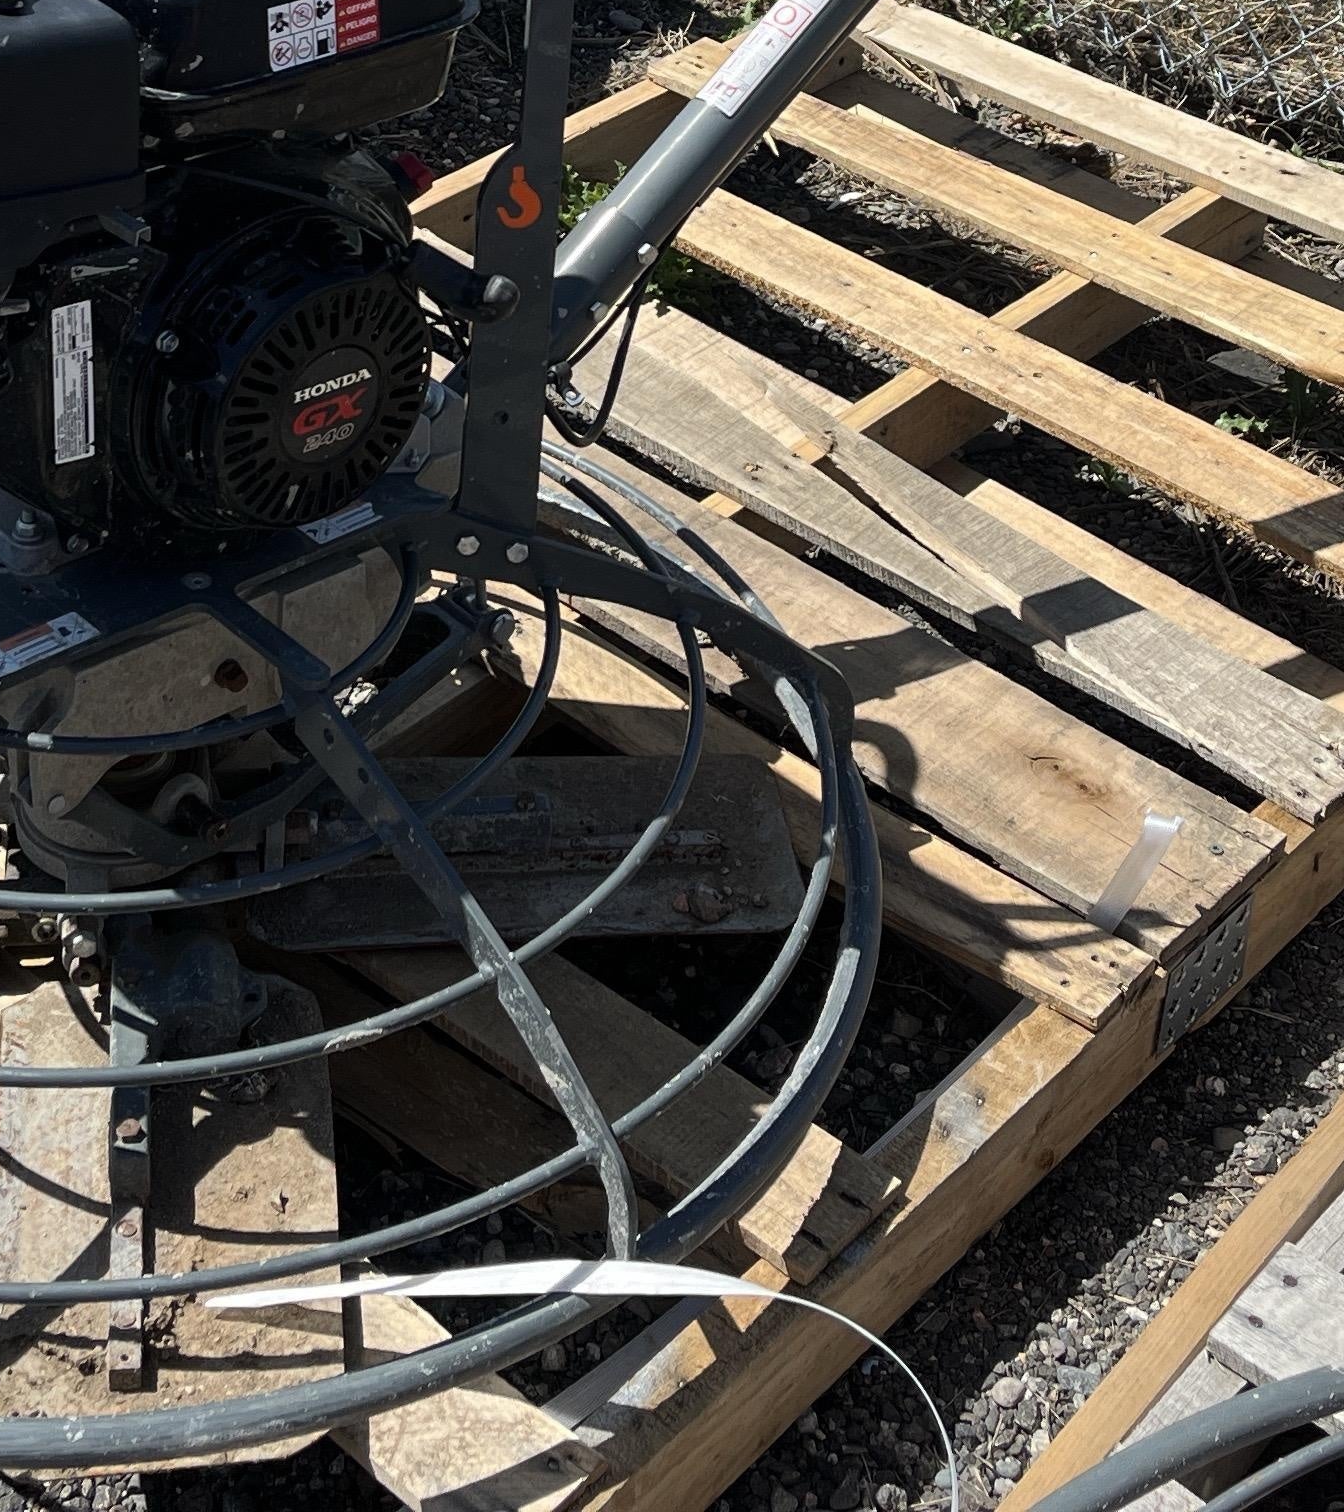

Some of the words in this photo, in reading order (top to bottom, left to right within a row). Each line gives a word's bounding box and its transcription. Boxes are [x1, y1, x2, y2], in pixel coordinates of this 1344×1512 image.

[345, 0, 376, 15] GEFAHR
[345, 14, 377, 31] PELIGRO
[346, 30, 377, 46] DANGER
[294, 368, 372, 403] HONDA
[292, 387, 368, 435] GX
[303, 423, 355, 453] 240
